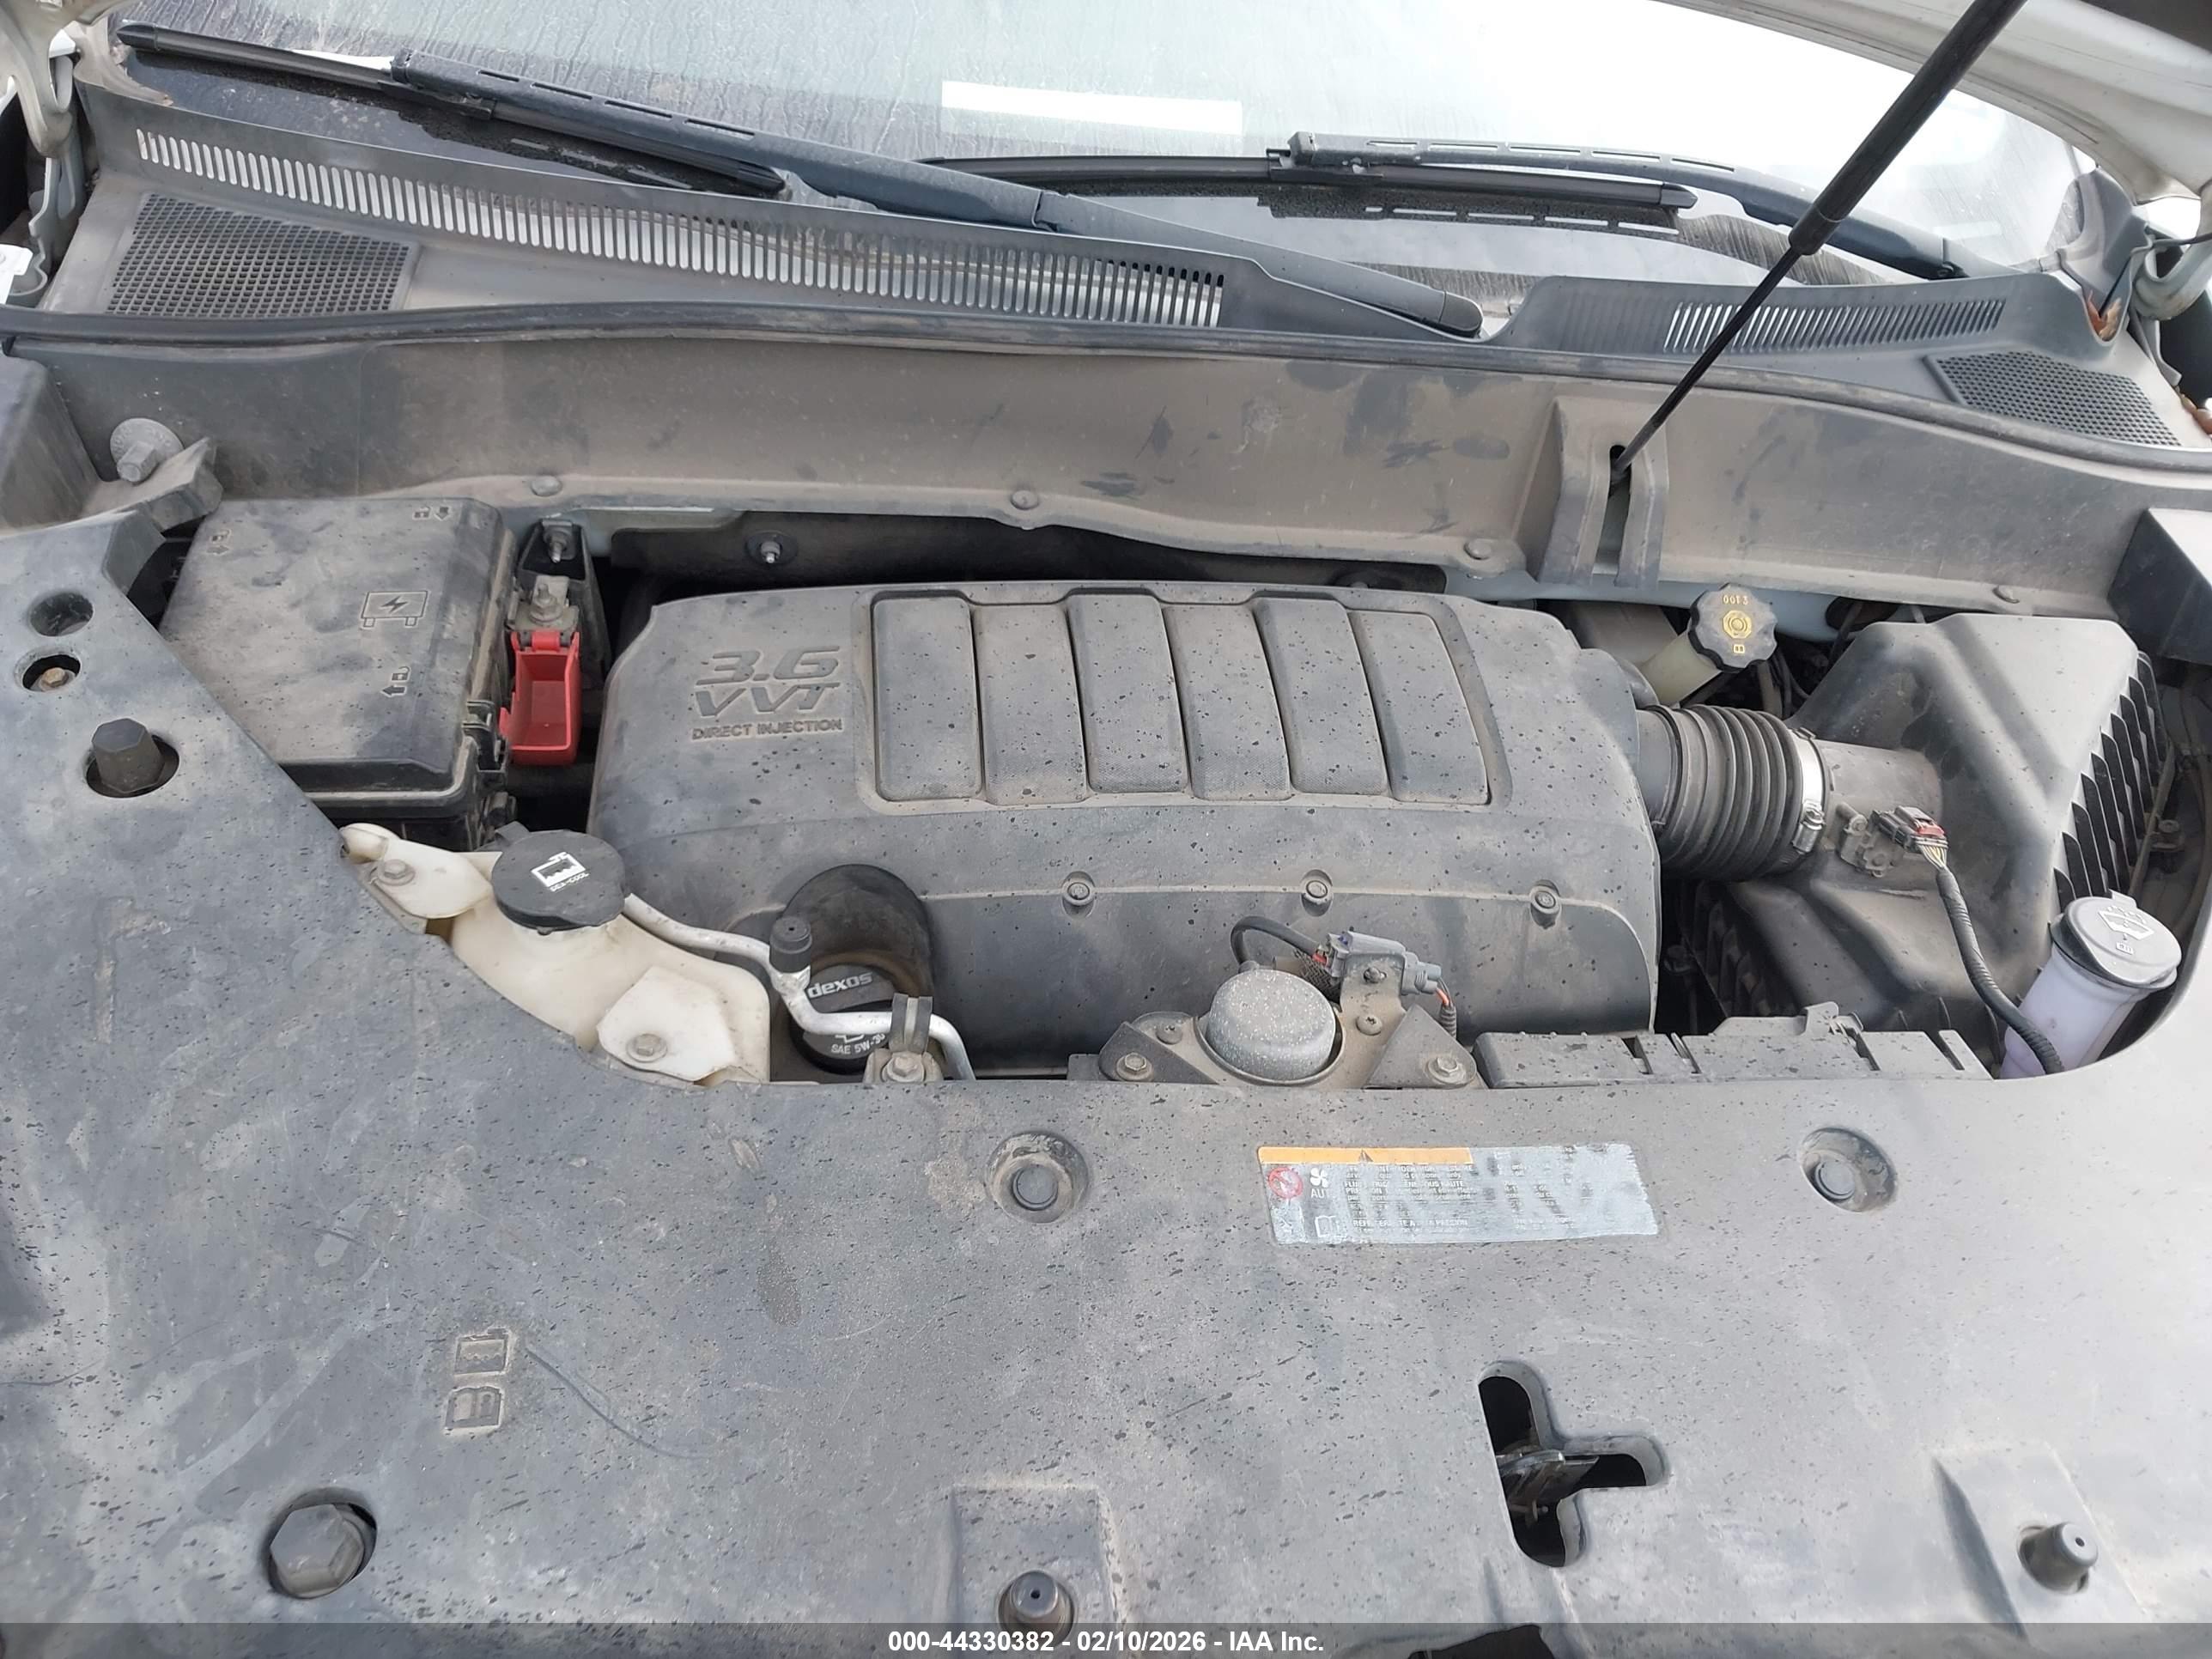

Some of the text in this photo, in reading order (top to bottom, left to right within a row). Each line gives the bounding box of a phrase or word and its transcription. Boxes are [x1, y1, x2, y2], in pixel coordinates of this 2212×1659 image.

[696, 646, 840, 685] 3.6
[696, 683, 841, 716] VVT
[692, 719, 842, 740] DIRECT INJECTION
[806, 971, 873, 999] dexos
[831, 1033, 886, 1054] SAE 5W-30
